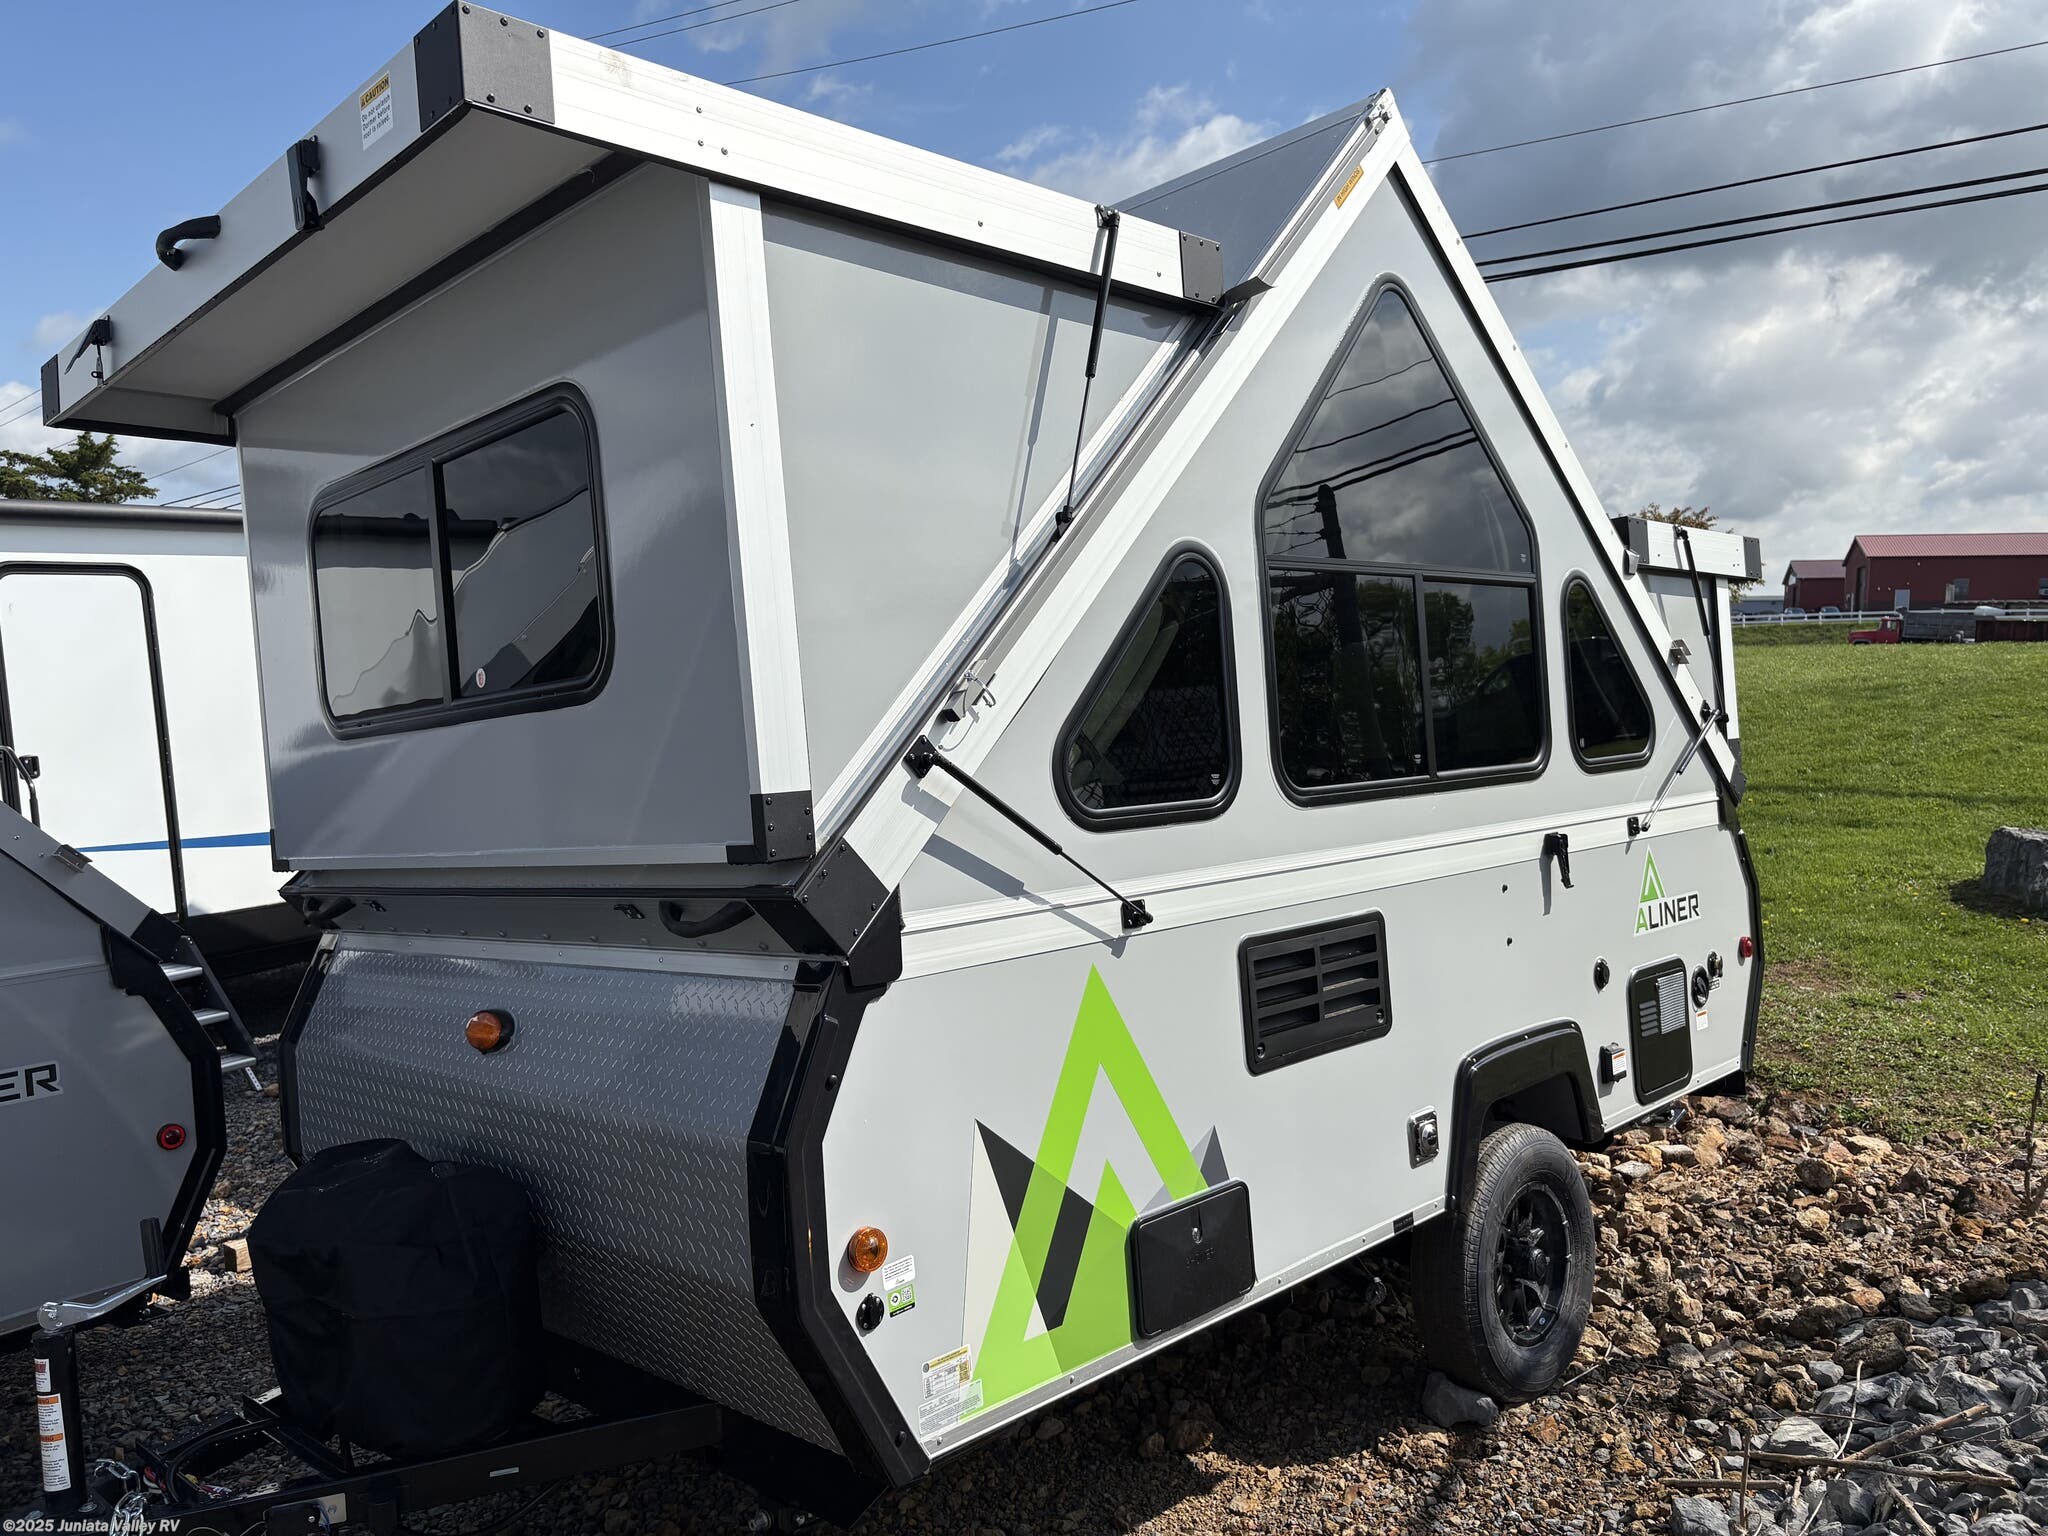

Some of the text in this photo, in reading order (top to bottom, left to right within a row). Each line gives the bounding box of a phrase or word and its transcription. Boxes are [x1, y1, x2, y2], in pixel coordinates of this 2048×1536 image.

[365, 77, 390, 104] CAUTION
[362, 114, 368, 123] Do
[375, 94, 391, 111] unlatch
[362, 104, 391, 131] Dormer before
[363, 129, 372, 140] roof
[1635, 893, 1700, 934] ALINER
